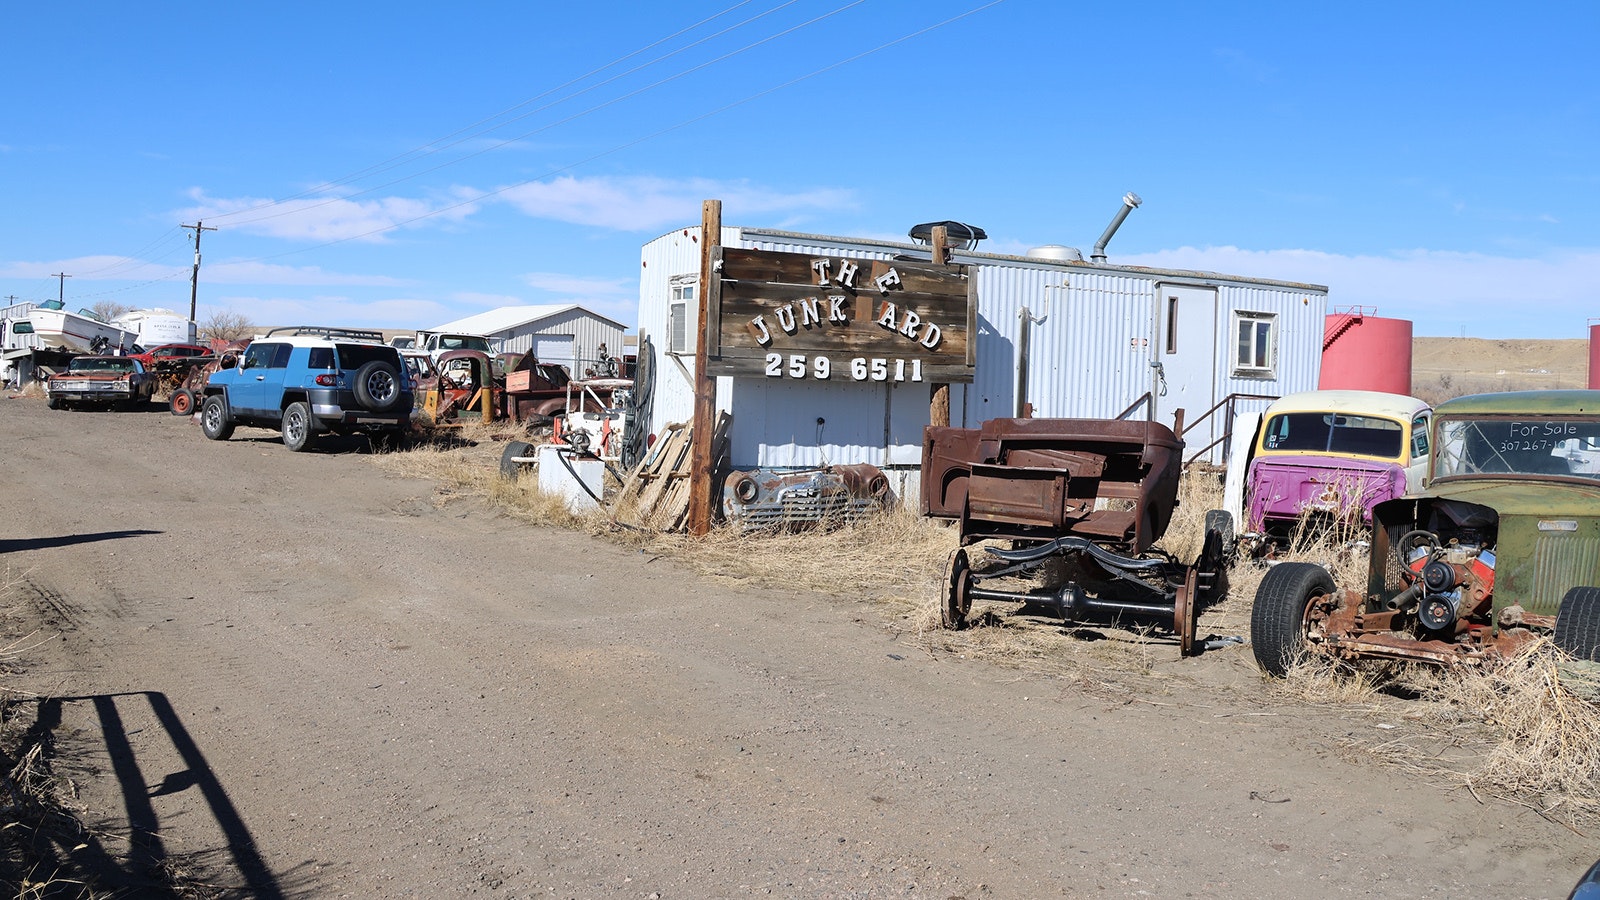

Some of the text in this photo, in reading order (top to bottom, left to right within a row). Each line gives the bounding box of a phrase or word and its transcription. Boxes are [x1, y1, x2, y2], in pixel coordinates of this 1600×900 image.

[812, 258, 900, 293] THE
[751, 294, 847, 345] JUNK
[765, 353, 923, 382] 259 6511
[1510, 421, 1577, 437] For Sale
[1500, 440, 1520, 453] 307
